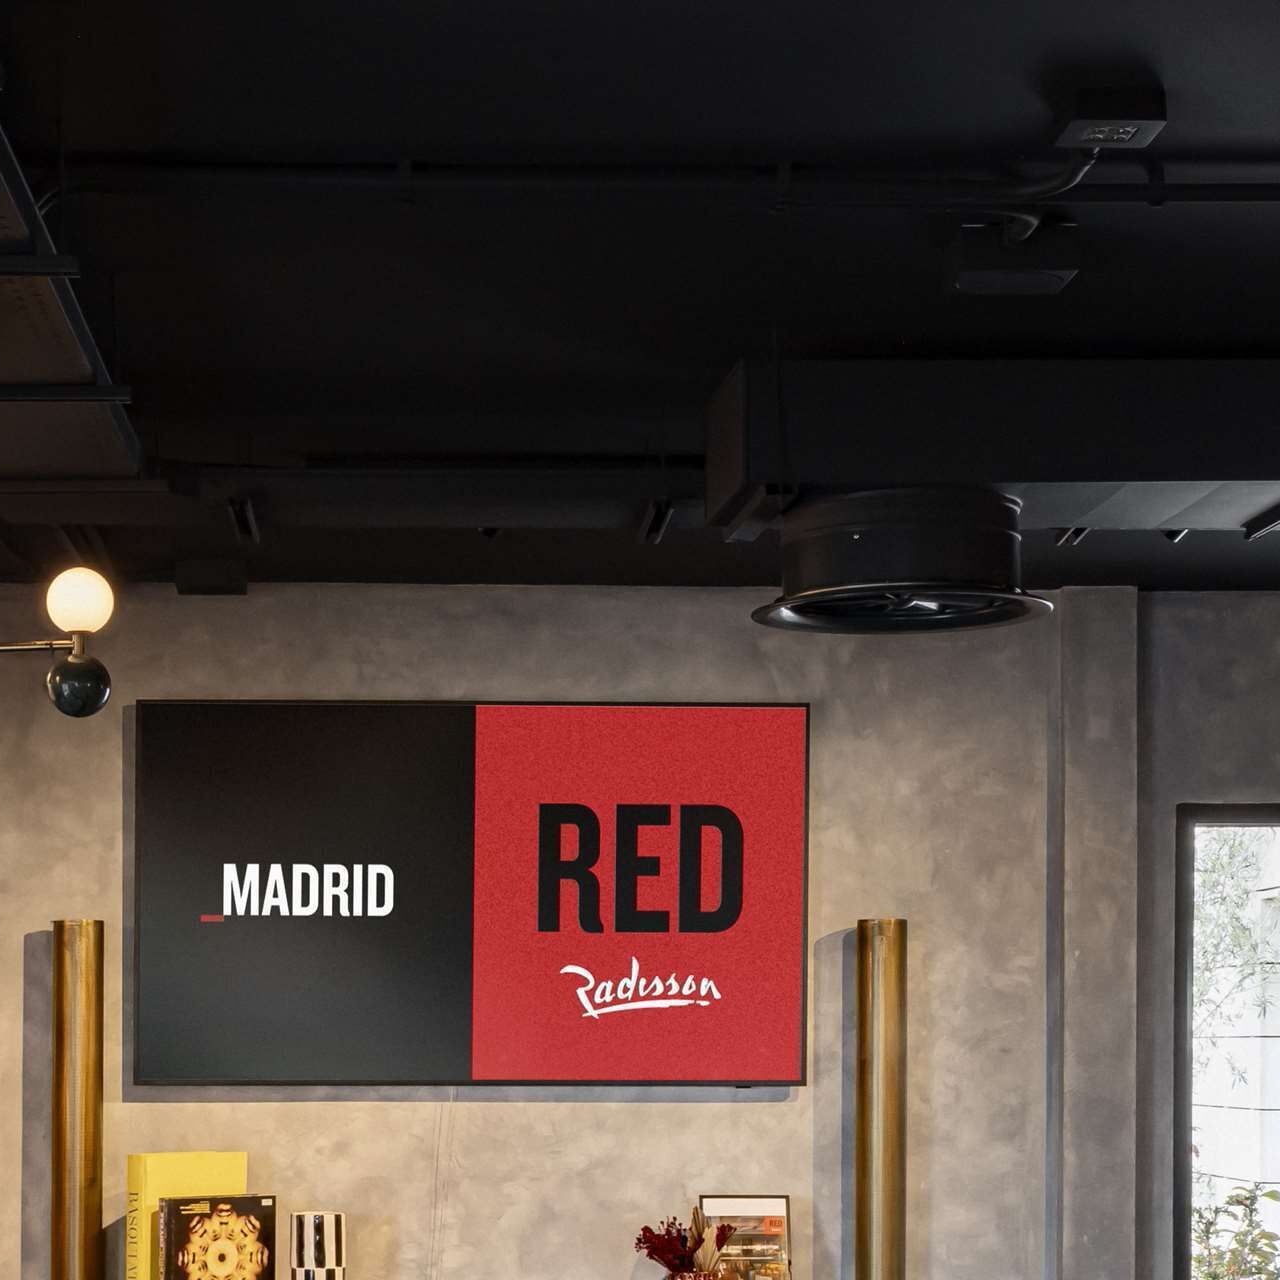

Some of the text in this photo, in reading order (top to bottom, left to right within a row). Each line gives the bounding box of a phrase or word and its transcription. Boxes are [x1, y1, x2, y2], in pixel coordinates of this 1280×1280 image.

[537, 802, 745, 934] RED
[560, 956, 722, 1019] Radisson
[128, 1191, 139, 1280] BASQUIAT
